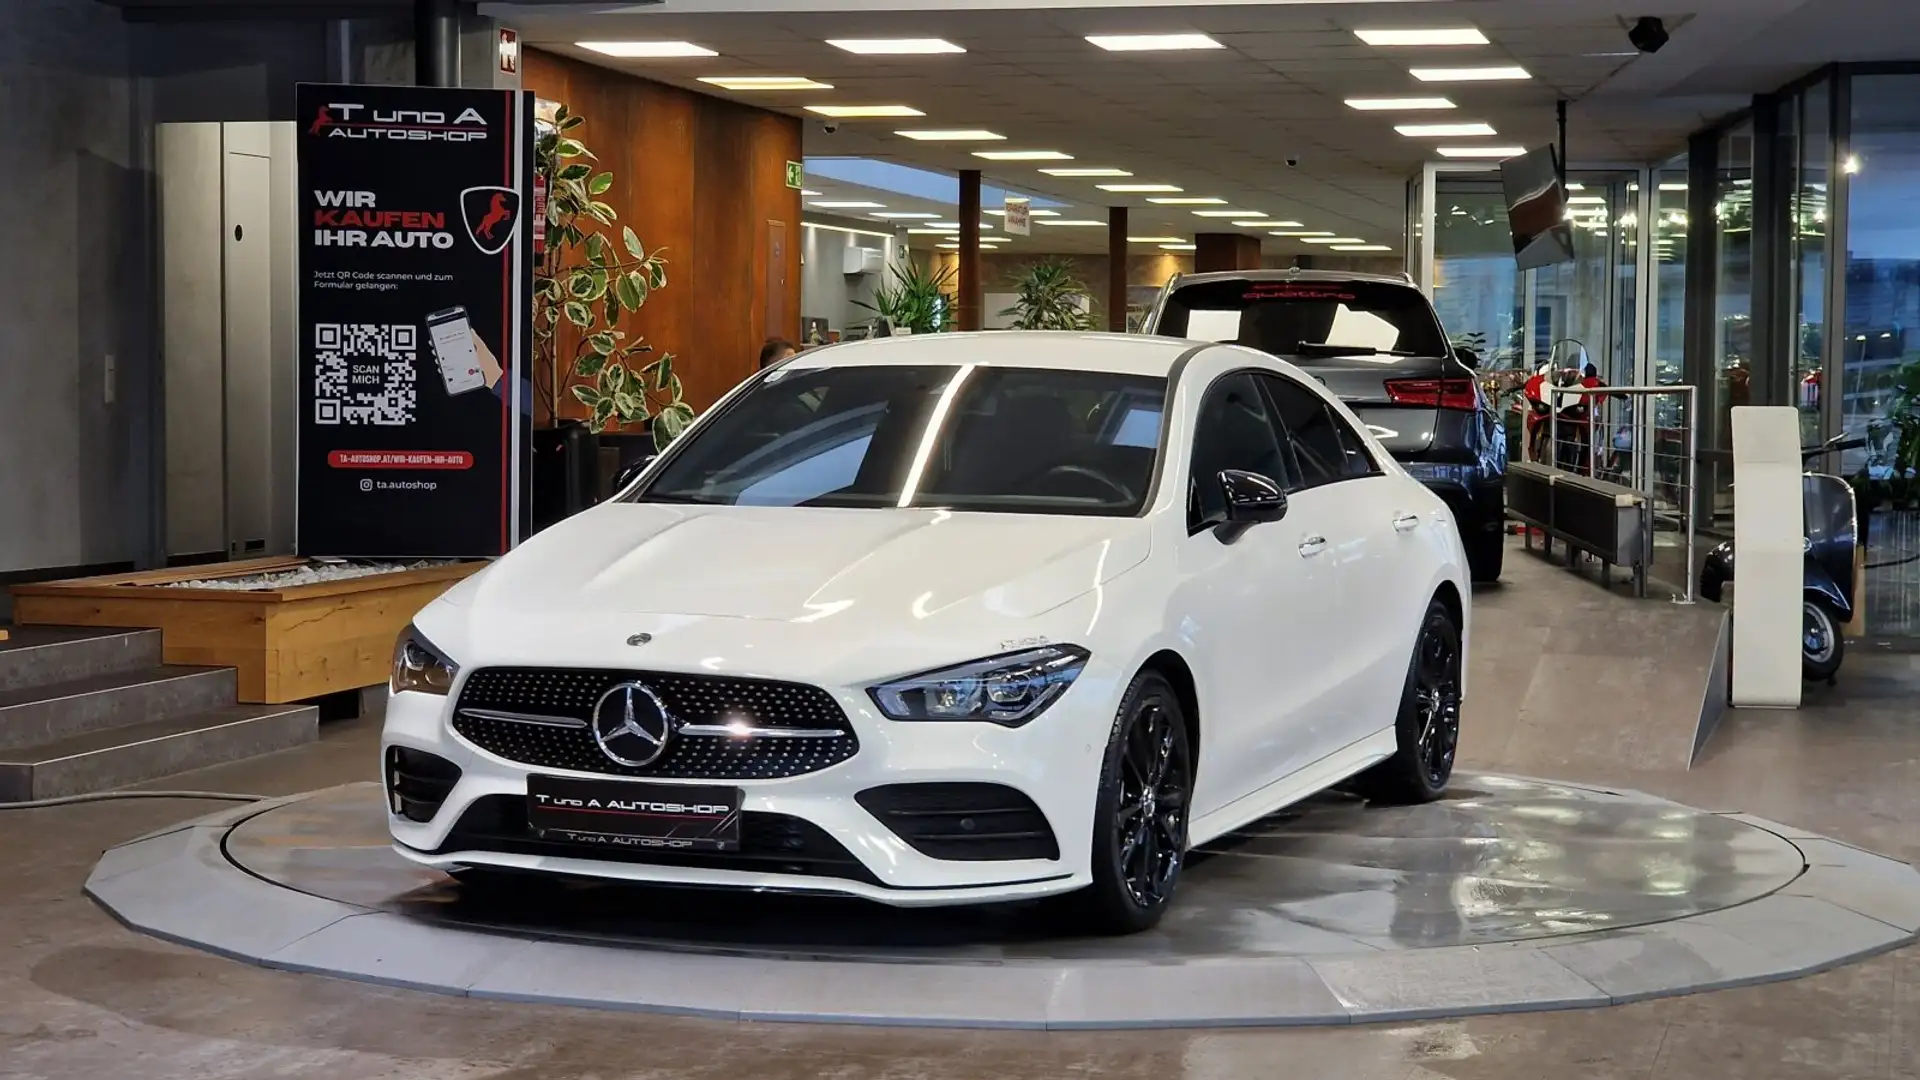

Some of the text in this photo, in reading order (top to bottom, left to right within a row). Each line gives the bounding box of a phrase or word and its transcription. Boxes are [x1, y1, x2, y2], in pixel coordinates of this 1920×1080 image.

[328, 103, 365, 121] T
[453, 107, 488, 125] A
[328, 127, 488, 142] AUTOSHOP
[314, 190, 376, 208] WIR
[314, 209, 445, 229] KAUFEN
[314, 230, 454, 249] IHR AUTO
[313, 271, 335, 280] Jetzt
[336, 271, 351, 280] QR
[352, 271, 375, 280] Code
[376, 272, 413, 281] scannen
[415, 272, 432, 281] und
[314, 280, 399, 291] Formular gelangen:
[1242, 291, 1356, 299] quattro
[352, 364, 380, 374] SCAN
[351, 374, 380, 385] MICH
[376, 480, 437, 491] ta.autoshop
[536, 794, 550, 804] T
[587, 799, 601, 808] A
[607, 799, 729, 814] AUTOSHOP
[567, 832, 578, 840] T
[612, 836, 692, 848] AUTOSHOP
